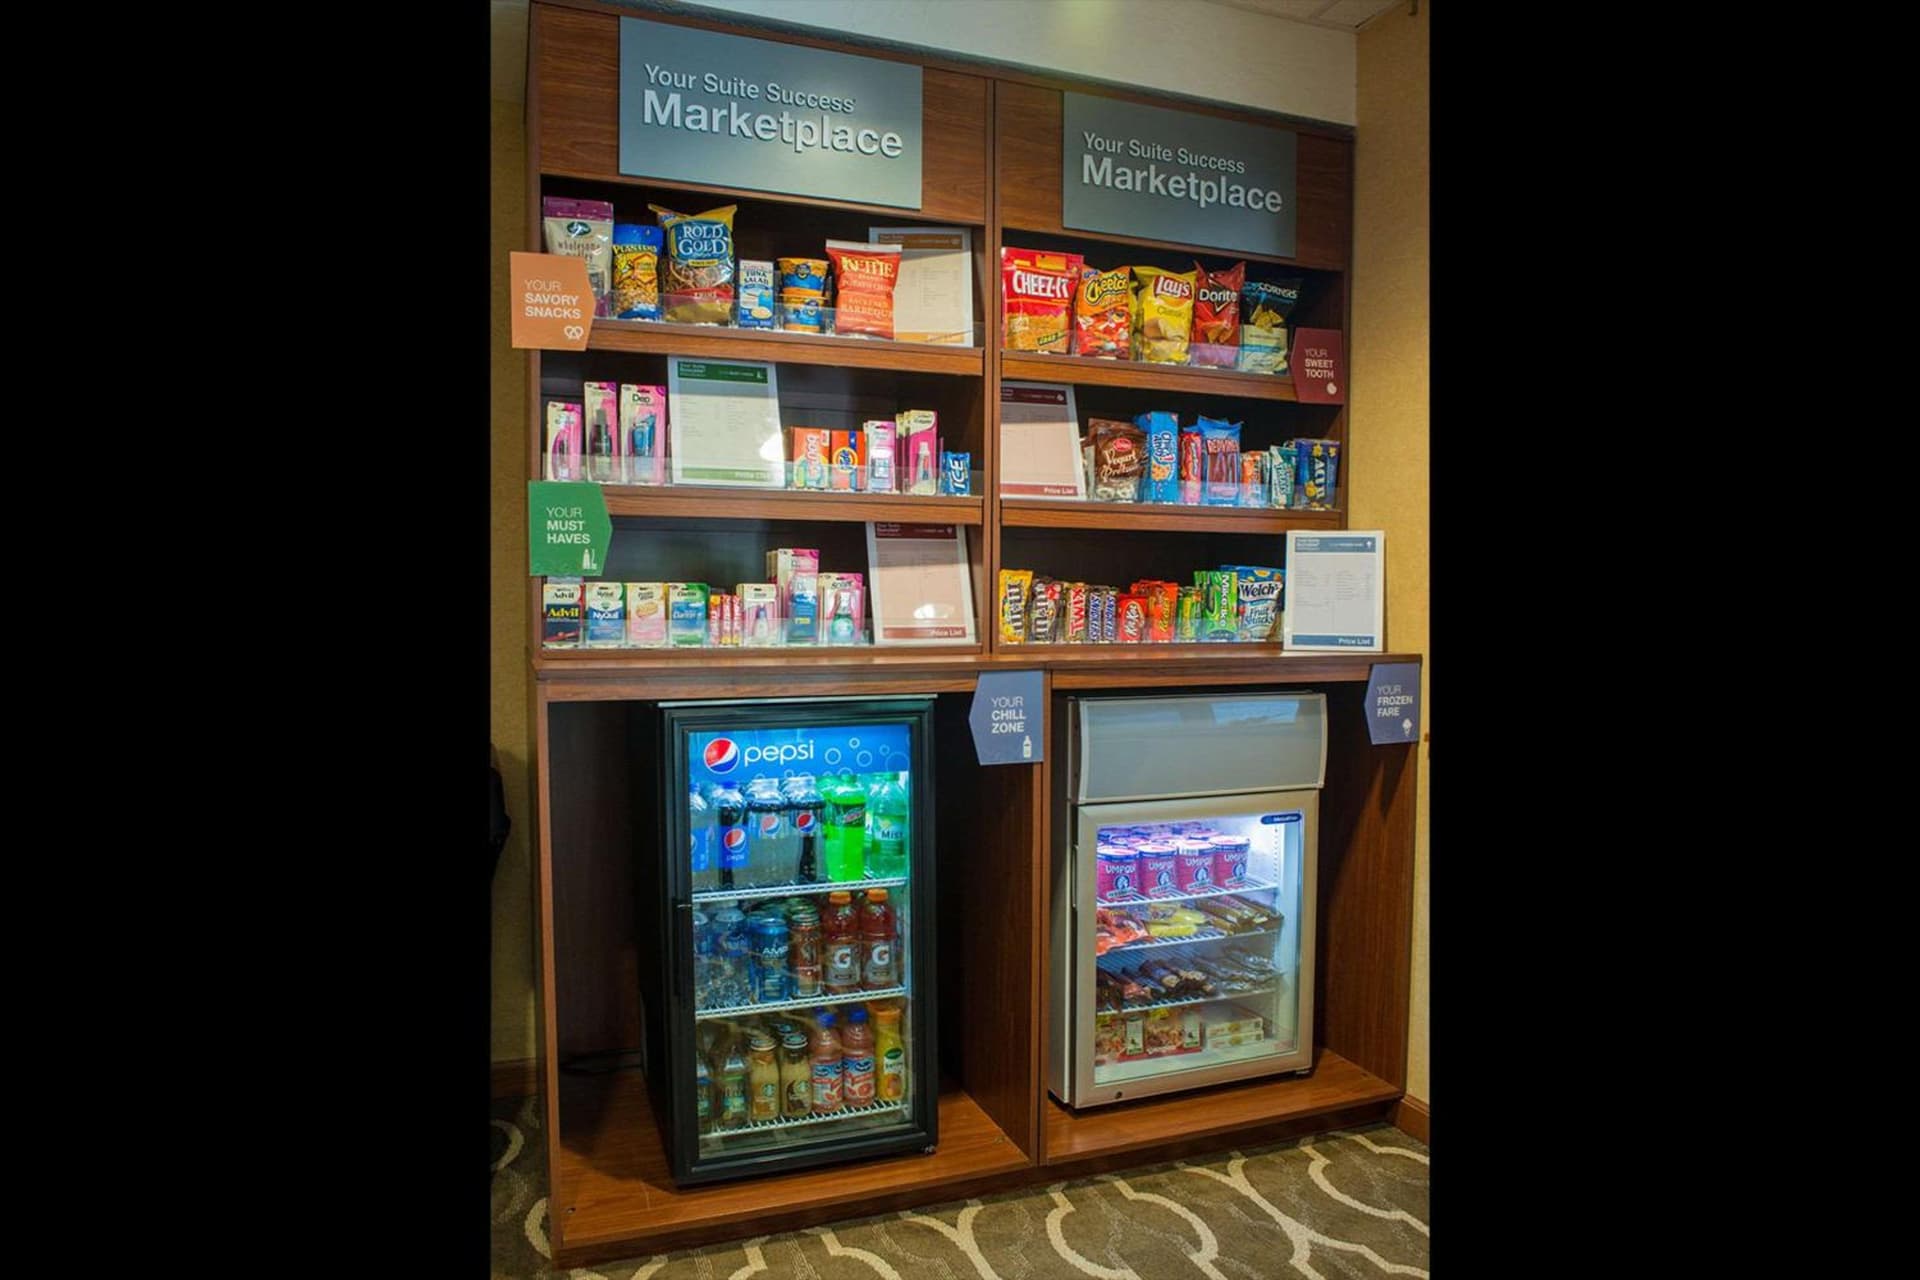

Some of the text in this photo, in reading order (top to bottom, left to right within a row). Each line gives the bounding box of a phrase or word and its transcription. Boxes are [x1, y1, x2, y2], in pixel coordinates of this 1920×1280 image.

[645, 63, 856, 113] Your Suite Success
[643, 89, 904, 157] Marketplace
[1083, 131, 1246, 174] Your Suite Success
[1082, 154, 1283, 213] Marketplace
[683, 223, 724, 240] ROLD
[678, 239, 728, 256] GOLD
[524, 279, 562, 291] YOUR
[1012, 270, 1069, 298] CHEEZ-IT
[1156, 276, 1190, 297] Lay's
[524, 293, 579, 305] SAVORY
[1199, 288, 1238, 302] Dorito
[524, 306, 582, 319] SNACKS
[1304, 348, 1328, 358] YOUR
[1304, 359, 1334, 369] SWEET
[1305, 369, 1334, 379] TOOTH
[546, 507, 583, 518] YOUR
[546, 520, 585, 531] MUST
[546, 533, 591, 544] HAVES
[548, 607, 579, 617] Advil
[1376, 685, 1402, 695] YOUR
[991, 696, 1023, 708] YOUR
[1377, 696, 1413, 706] FROZEN
[991, 709, 1026, 721] CHILL
[1377, 707, 1400, 717] FARE
[991, 722, 1024, 734] ZONE
[744, 739, 814, 767] pepsi
[833, 948, 851, 969] G
[872, 943, 890, 966] G
